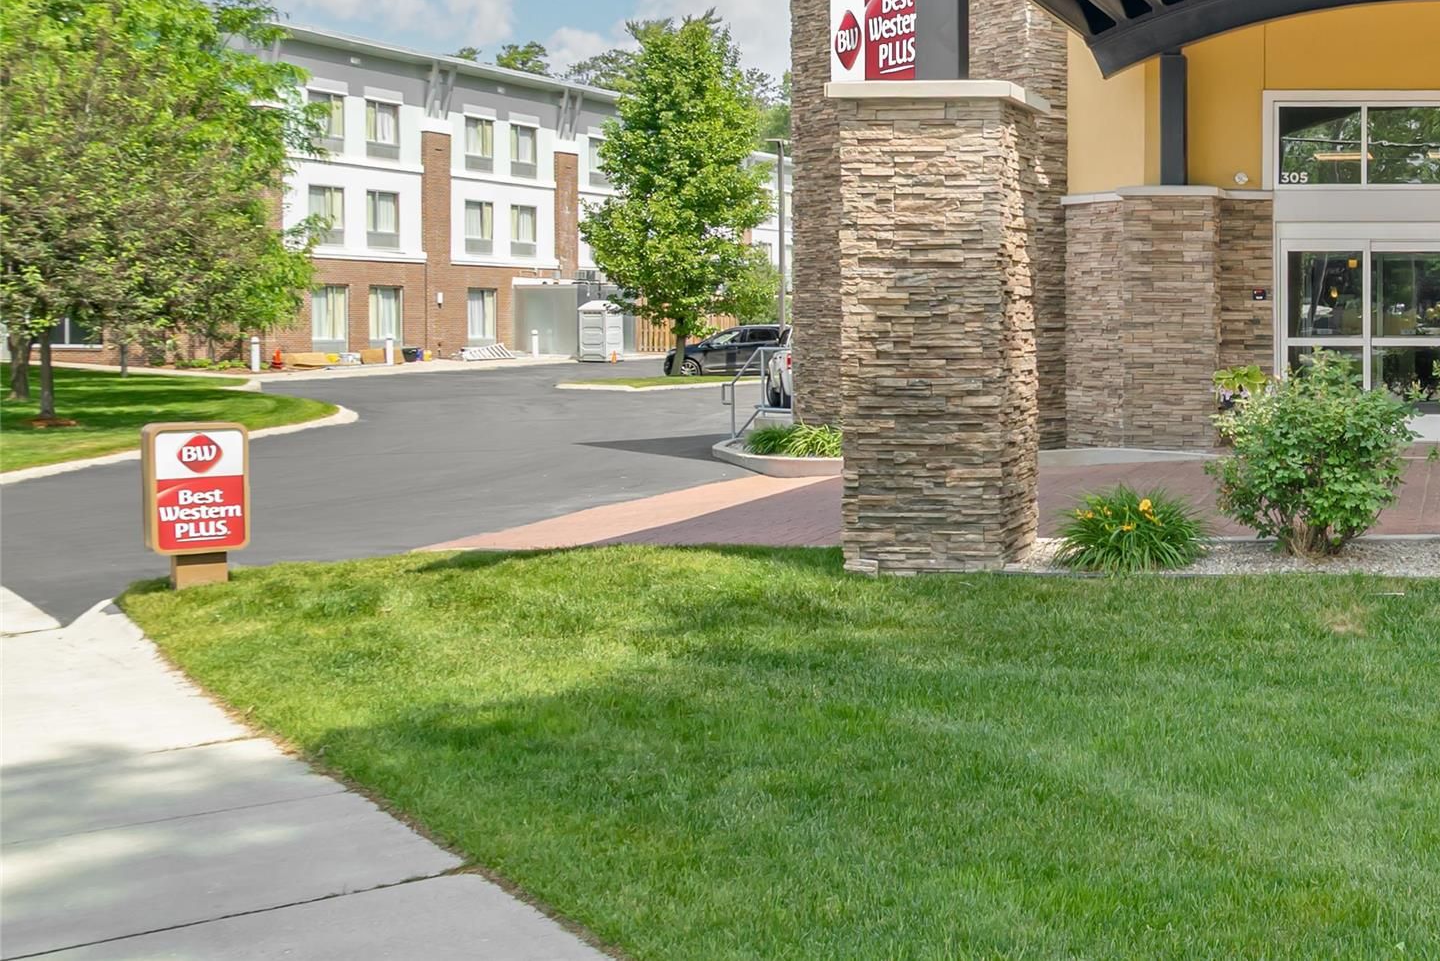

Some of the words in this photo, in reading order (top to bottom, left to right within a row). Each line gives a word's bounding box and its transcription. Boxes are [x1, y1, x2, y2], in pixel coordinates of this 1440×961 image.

[868, 13, 917, 42] Wester
[837, 27, 859, 53] BW
[879, 37, 916, 68] PLUS
[1281, 172, 1308, 183] 305
[182, 445, 217, 462] BW
[178, 489, 224, 505] Best
[159, 505, 242, 522] Western
